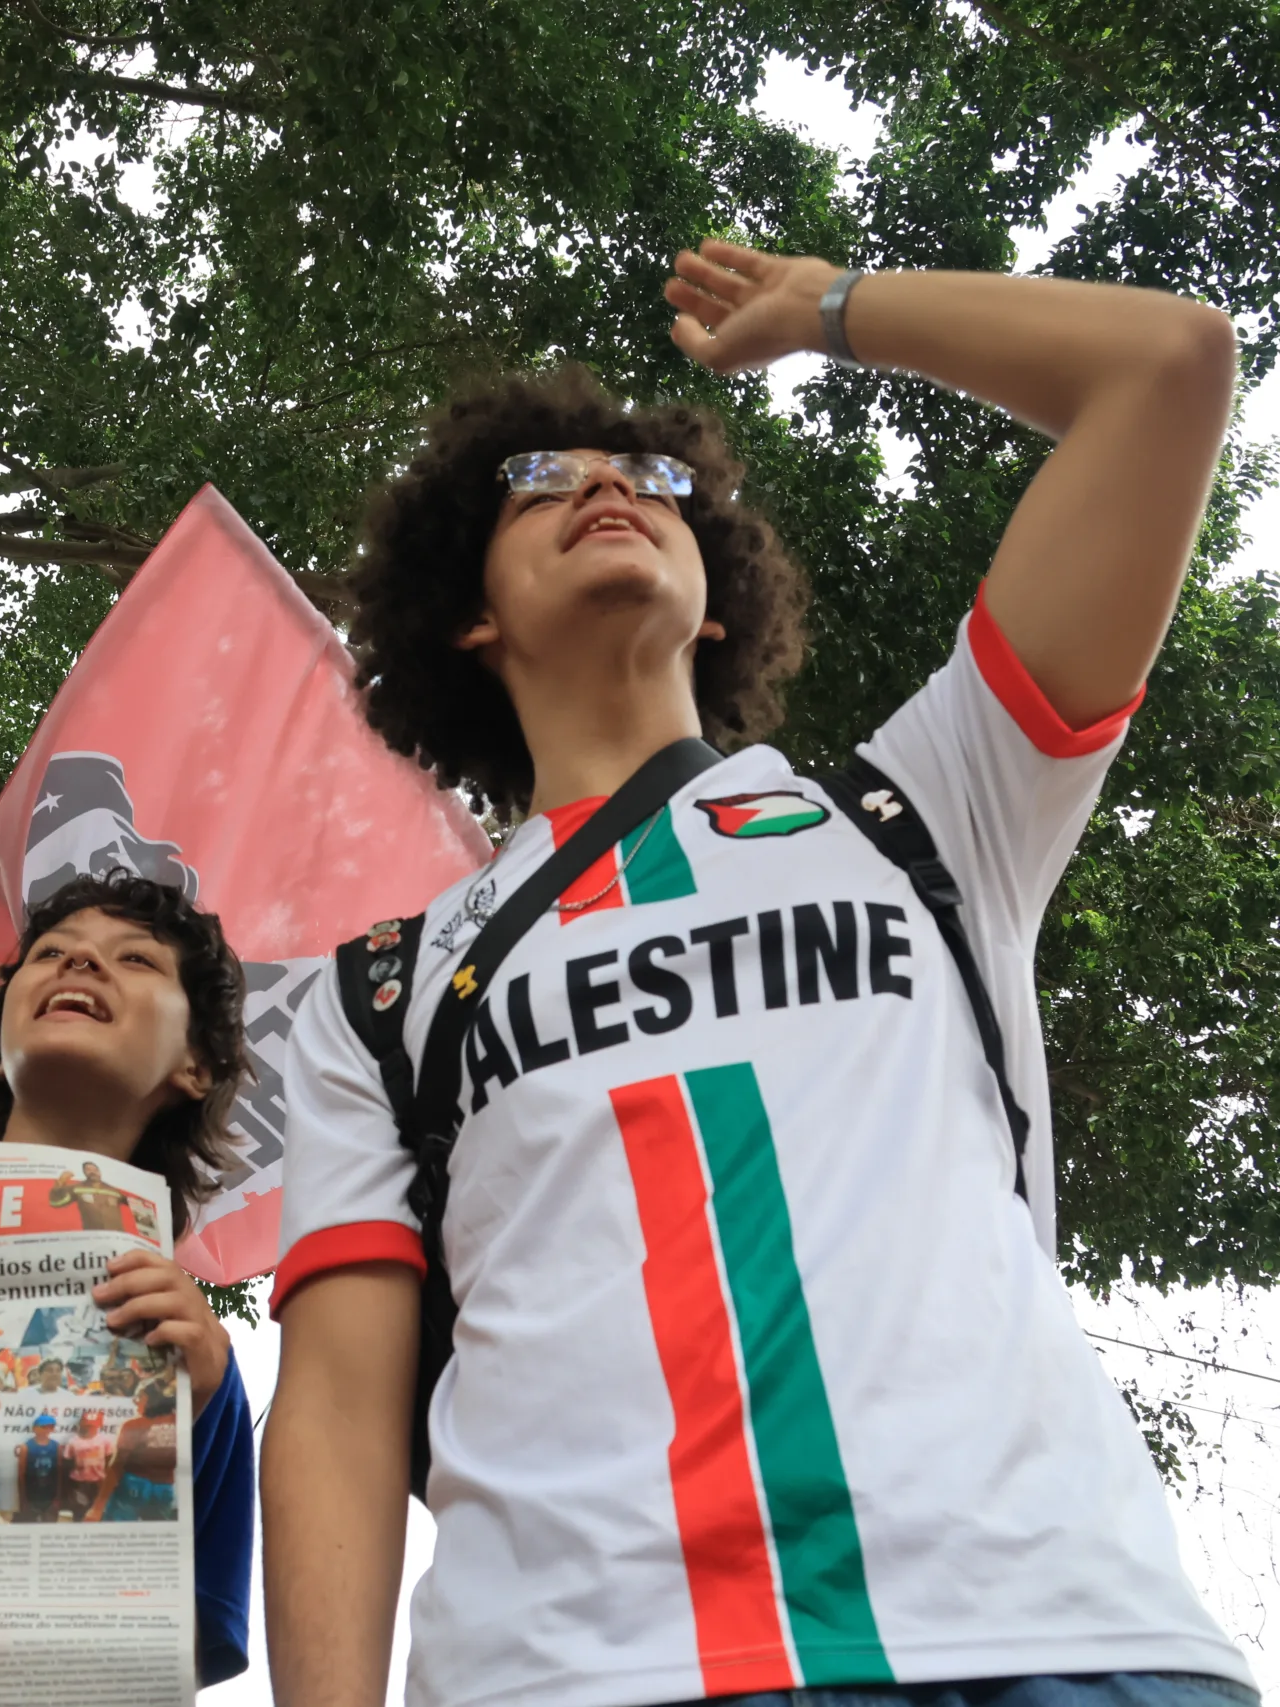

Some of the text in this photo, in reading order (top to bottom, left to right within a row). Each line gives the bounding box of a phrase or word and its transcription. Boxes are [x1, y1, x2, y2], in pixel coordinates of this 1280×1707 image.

[460, 900, 913, 1116] ALESTINE
[38, 1253, 66, 1273] de
[72, 1250, 116, 1270] din
[3, 1403, 36, 1418] NÃO
